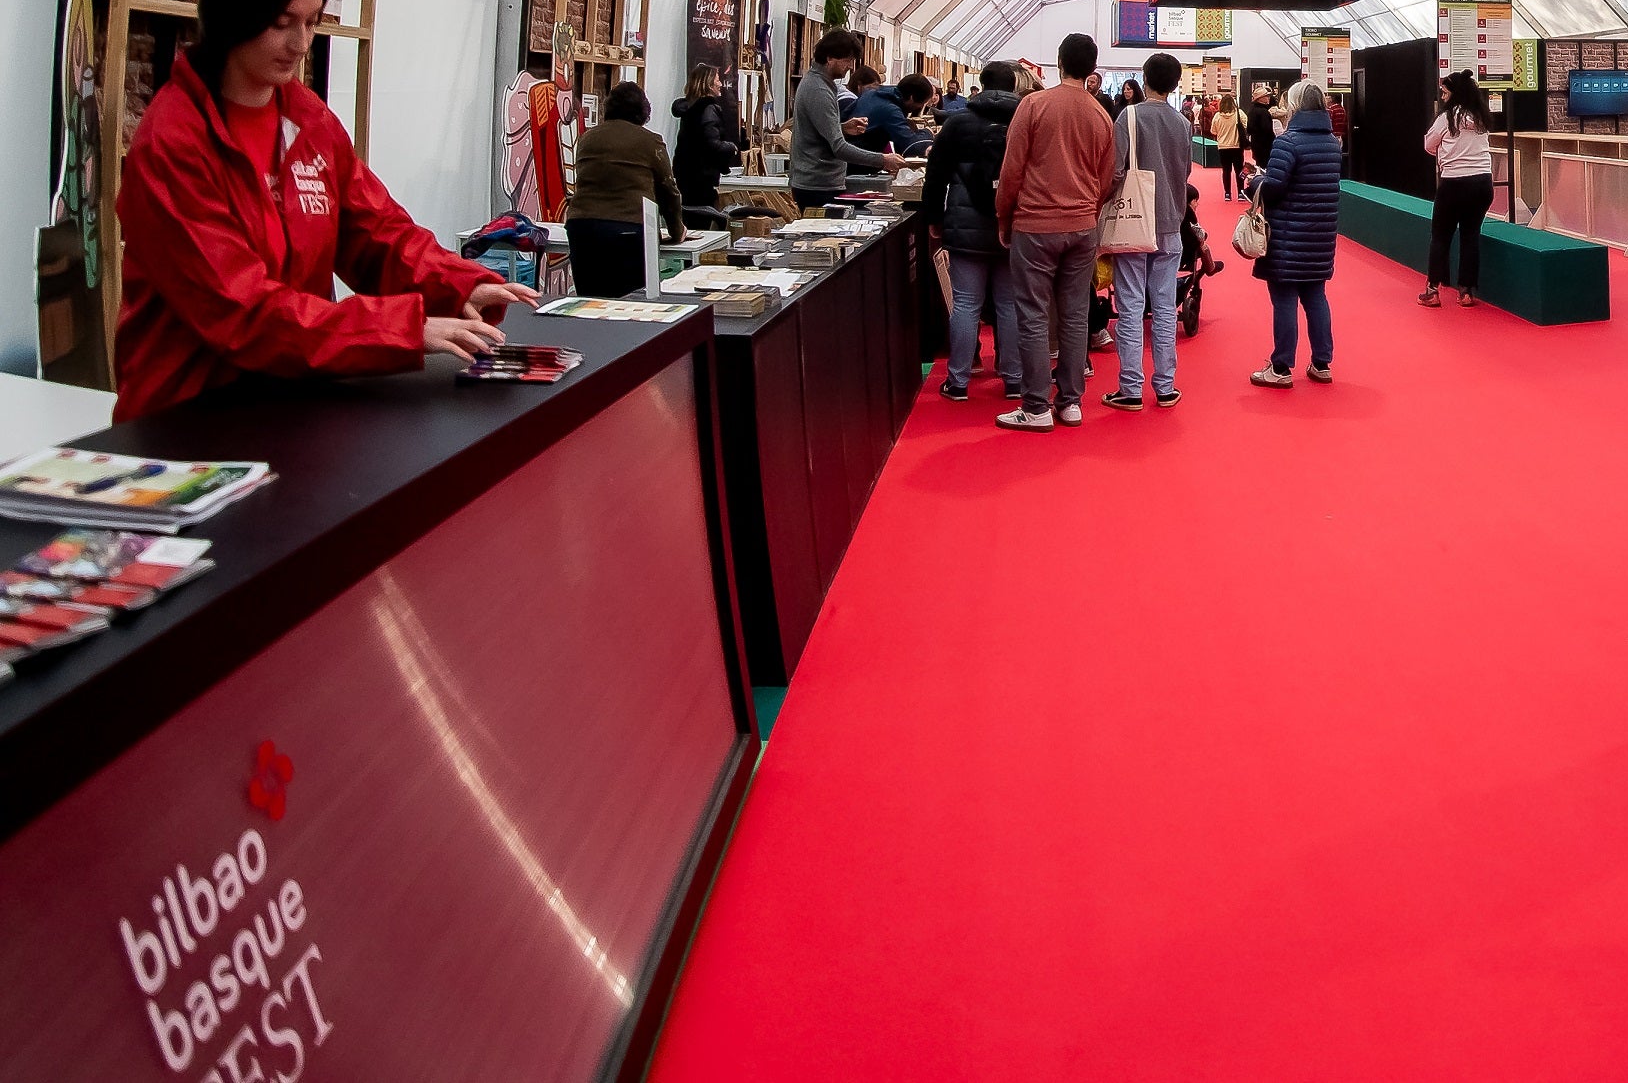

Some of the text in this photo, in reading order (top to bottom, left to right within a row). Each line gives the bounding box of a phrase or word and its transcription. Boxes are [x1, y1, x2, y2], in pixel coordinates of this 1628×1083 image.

[1525, 42, 1537, 88] gourmet
[299, 193, 330, 215] FEST
[118, 827, 268, 997] bilbao
[146, 877, 308, 1073] basque
[200, 942, 335, 1083] EST
